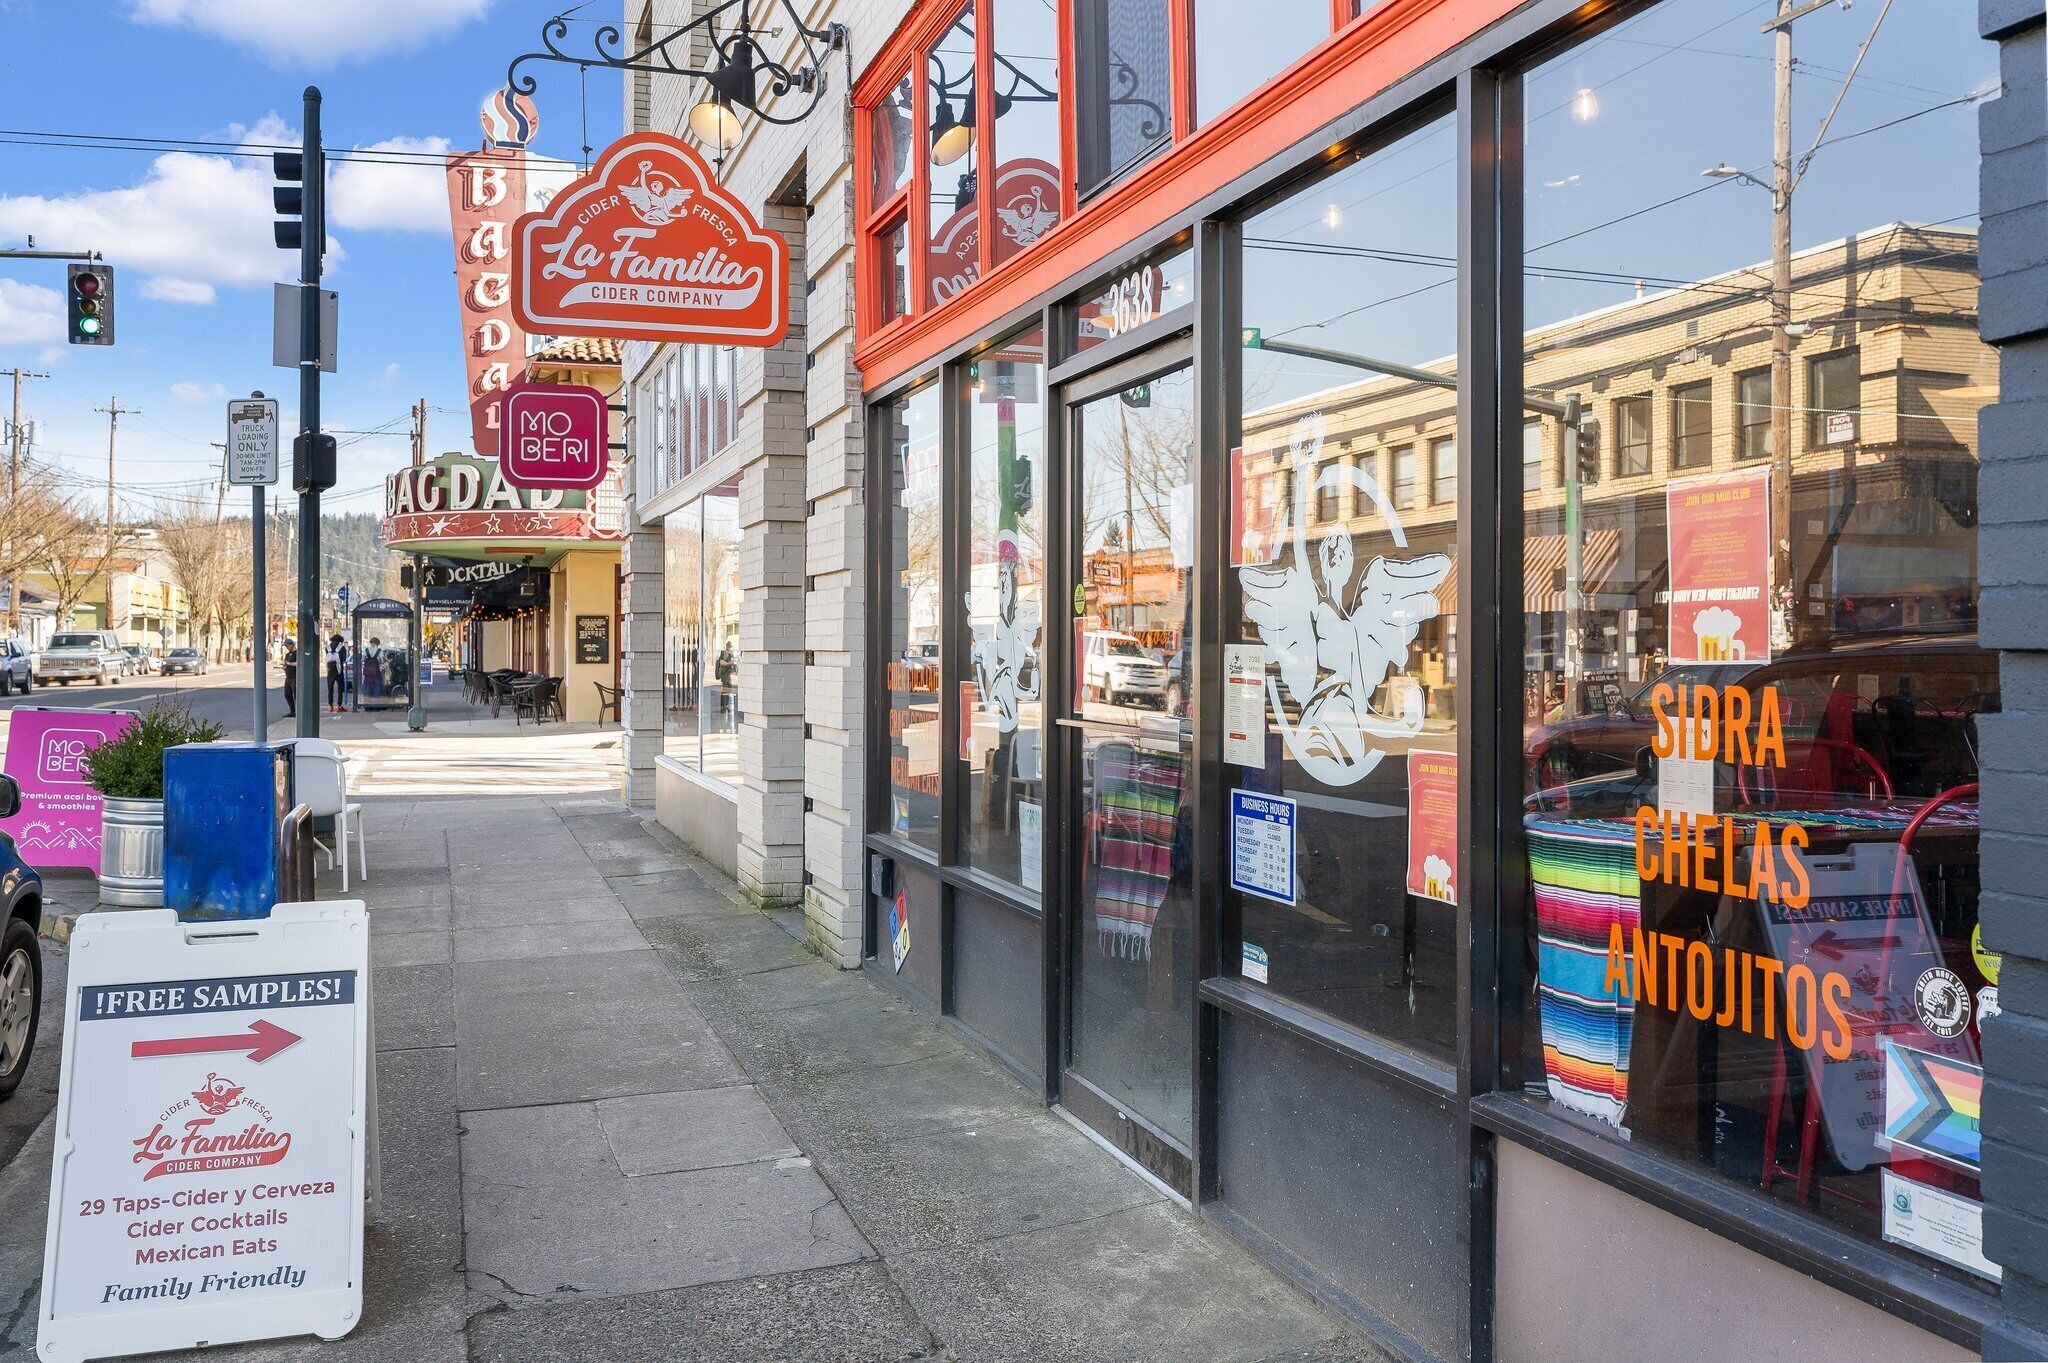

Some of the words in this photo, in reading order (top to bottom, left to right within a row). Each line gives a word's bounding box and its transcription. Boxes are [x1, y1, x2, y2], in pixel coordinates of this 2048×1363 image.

[577, 195, 621, 226] CIDER
[691, 204, 738, 248] FRESCA
[540, 225, 605, 280] La
[609, 226, 763, 286] Familia
[591, 286, 638, 302] CIDER
[646, 289, 724, 307] COMPANY
[1108, 264, 1153, 339] 3638
[241, 424, 265, 432] TRUCK
[520, 410, 572, 436] MO
[237, 432, 269, 441] LOADING
[237, 441, 268, 452] ONLY
[520, 436, 589, 463] BERI
[239, 459, 267, 467] 7AM-2PM
[1684, 494, 1700, 507] JOIN
[1701, 492, 1716, 505] OUR
[1716, 490, 1733, 503] MUG
[446, 562, 523, 585] OCKTAIL
[1650, 682, 1787, 768] SIDRA
[48, 739, 86, 756] MO
[46, 755, 95, 772] BER
[1418, 763, 1429, 773] JOIN
[21, 792, 61, 801] Premium
[64, 792, 84, 801] acai
[47, 803, 96, 811] smoothies
[1241, 797, 1269, 813] BUSINESS
[1269, 802, 1290, 818] HOURS
[1237, 816, 1254, 827] MONDAY
[1267, 823, 1281, 832] CLOSED
[1237, 826, 1255, 836] TUESDAY
[1267, 833, 1281, 842] CLOSED
[1237, 836, 1261, 849] WEDNESDAY
[1237, 845, 1258, 856] THURSDAY
[1237, 854, 1251, 864] FRIDAY
[1635, 805, 1810, 909] CHELAS
[1237, 864, 1257, 875] SATURDAY
[1237, 872, 1253, 883] SUNDAY
[96, 986, 186, 1015] !FREE
[192, 978, 342, 1009] SAMPLES!
[1603, 922, 1853, 1060] ANTOJITOS
[1935, 969, 1954, 983] HAVE
[1954, 981, 1969, 1013] COFFEE
[1936, 1026, 1952, 1036] 2017
[160, 1099, 191, 1122] CIDER
[241, 1097, 273, 1124] FRESCA
[132, 1123, 178, 1164] La
[181, 1117, 291, 1156] Familia
[166, 1160, 201, 1172] CIDER
[206, 1154, 262, 1169] COMPANY
[79, 1198, 106, 1217] 29
[112, 1188, 229, 1215] Taps-Cider
[233, 1188, 247, 1206] y
[252, 1180, 336, 1200] Cerveza
[126, 1218, 185, 1239] Cider
[190, 1208, 289, 1233] Cocktails
[135, 1241, 225, 1266] Mexican
[232, 1237, 278, 1256] Eats
[100, 1276, 193, 1304] Family
[198, 1265, 307, 1294] Friendly
